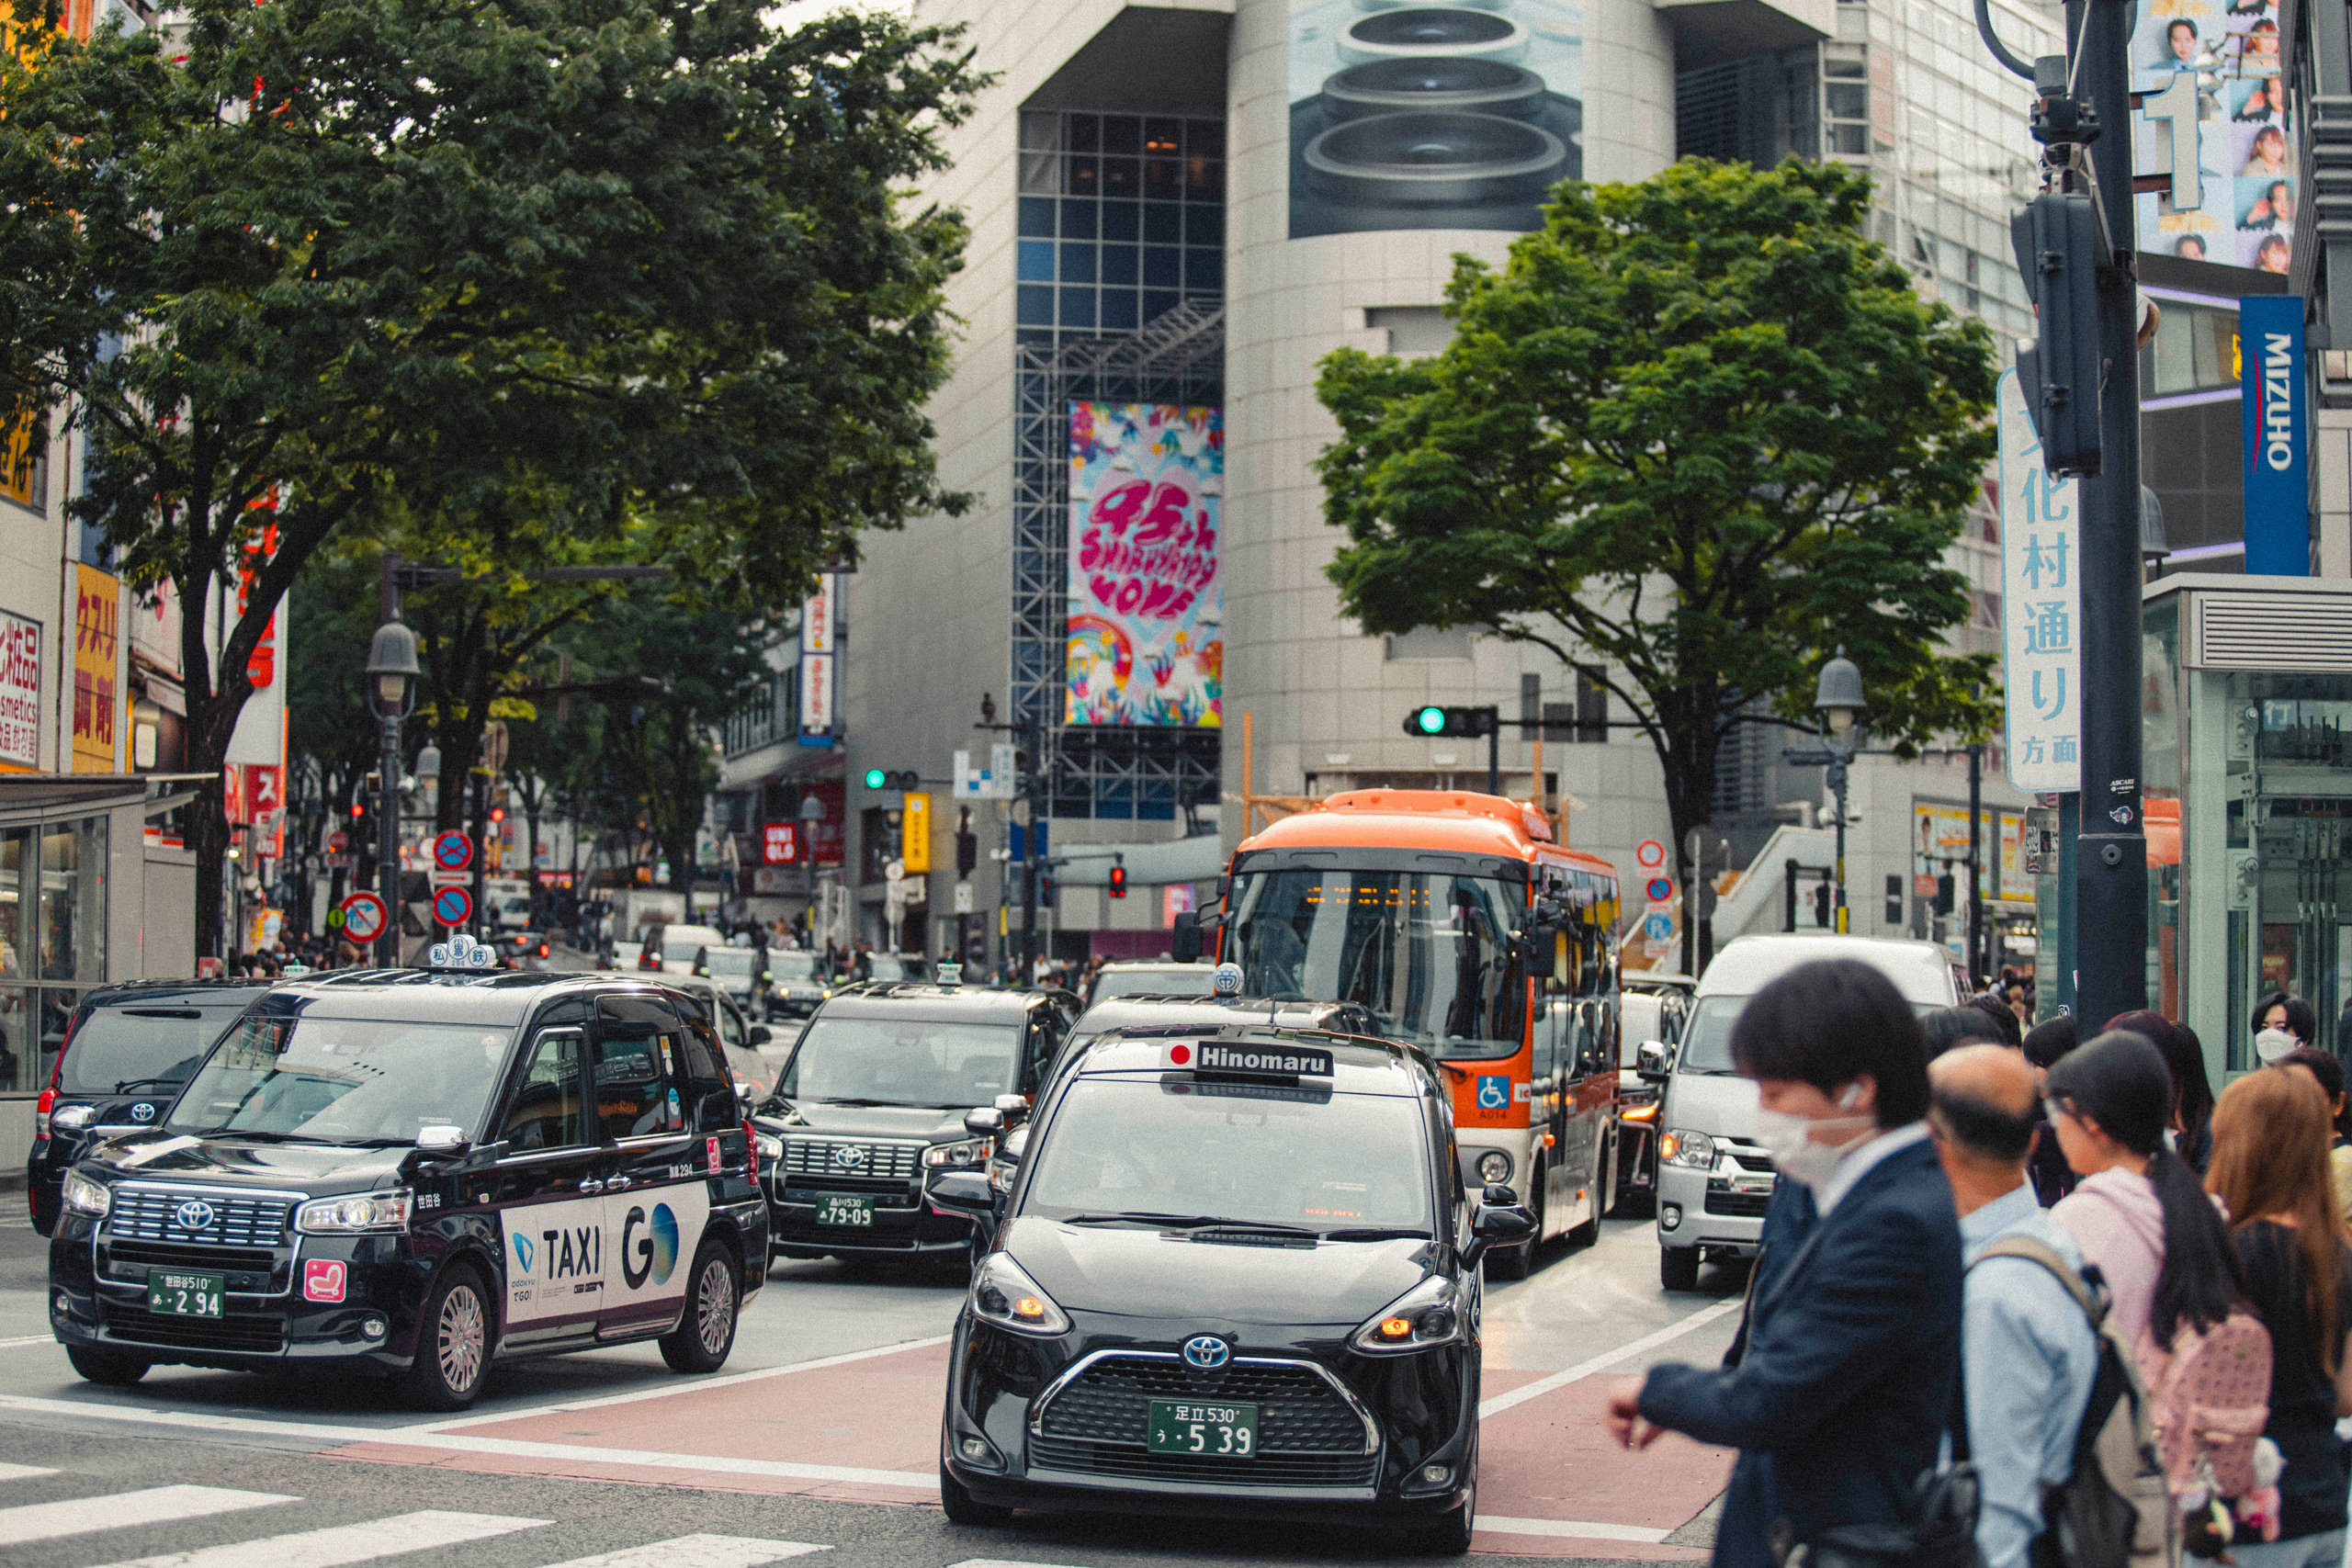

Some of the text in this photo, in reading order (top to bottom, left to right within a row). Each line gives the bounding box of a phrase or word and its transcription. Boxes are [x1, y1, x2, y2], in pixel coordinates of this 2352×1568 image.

[2265, 332, 2292, 471] MIZUHO
[1090, 572, 1195, 620] LOVE
[77, 584, 116, 662] クスリ
[2021, 735, 2078, 764] 方面
[766, 827, 792, 842] UNI
[766, 842, 795, 861] QLO
[472, 950, 484, 963] 鉄
[1202, 1047, 1325, 1073] Hinomaru
[417, 1192, 441, 1210] 世田谷
[829, 1207, 871, 1224] 79-09
[543, 1202, 680, 1291] TAXI GO
